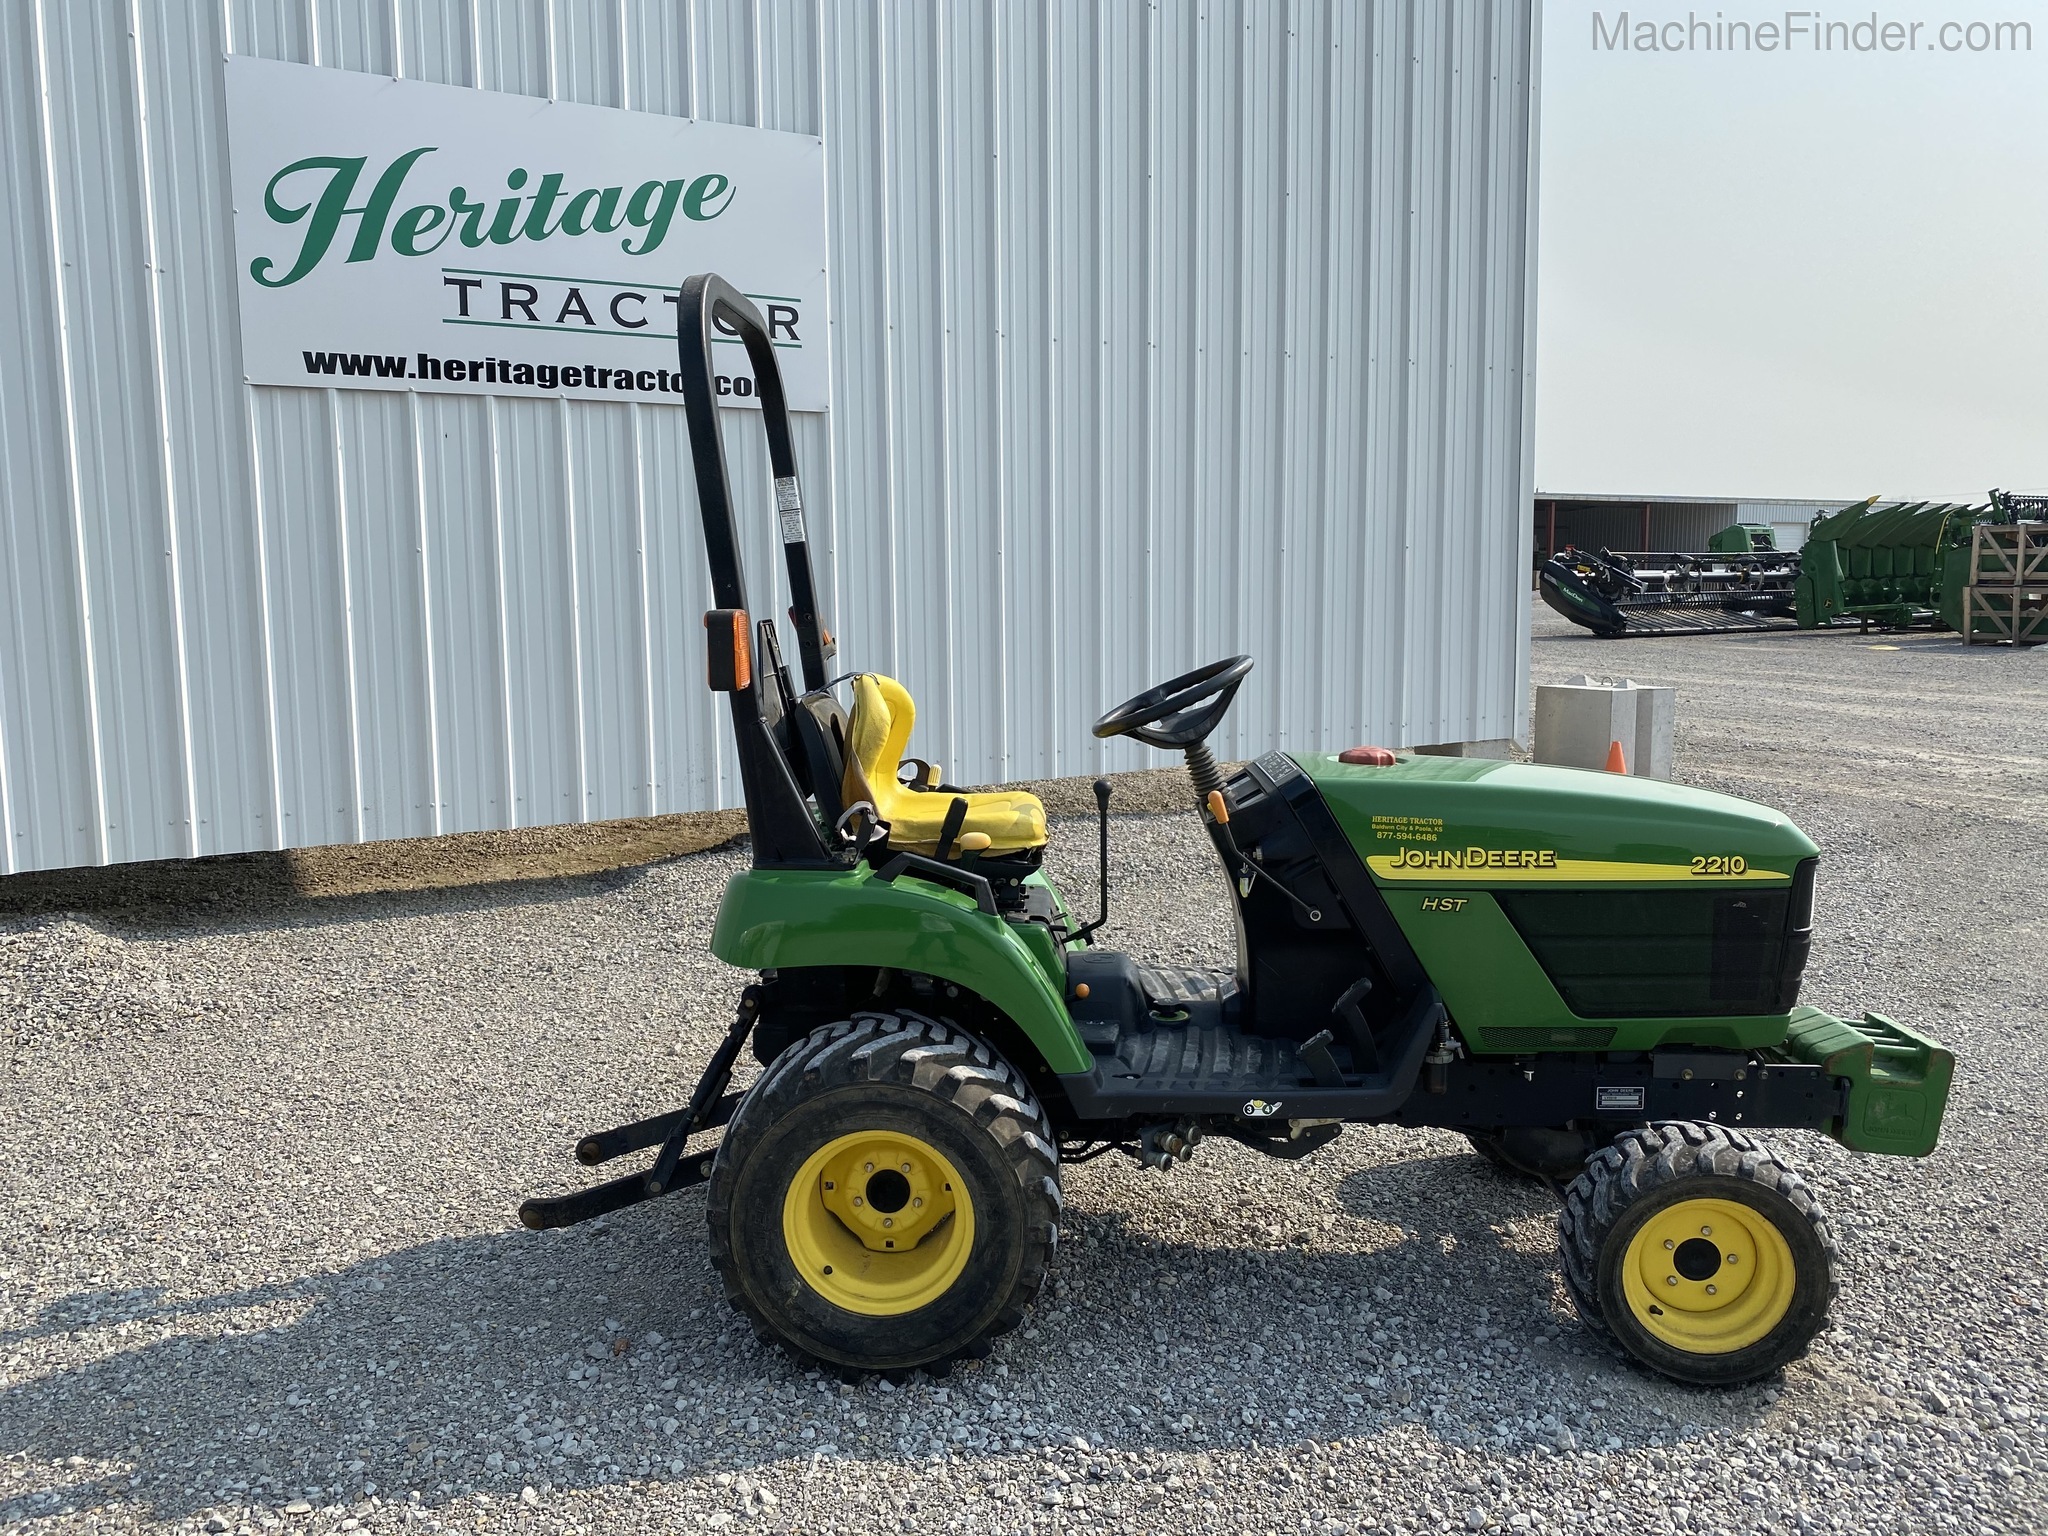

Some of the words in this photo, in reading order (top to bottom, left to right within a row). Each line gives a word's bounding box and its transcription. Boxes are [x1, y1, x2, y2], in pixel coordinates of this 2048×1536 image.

[250, 147, 737, 288] Heritage
[443, 276, 801, 341] TRACR
[302, 350, 762, 398] www.heritagetractoco
[1409, 817, 1443, 825] TRACTOR
[1691, 856, 1748, 876] 2210
[1421, 896, 1468, 913] HST
